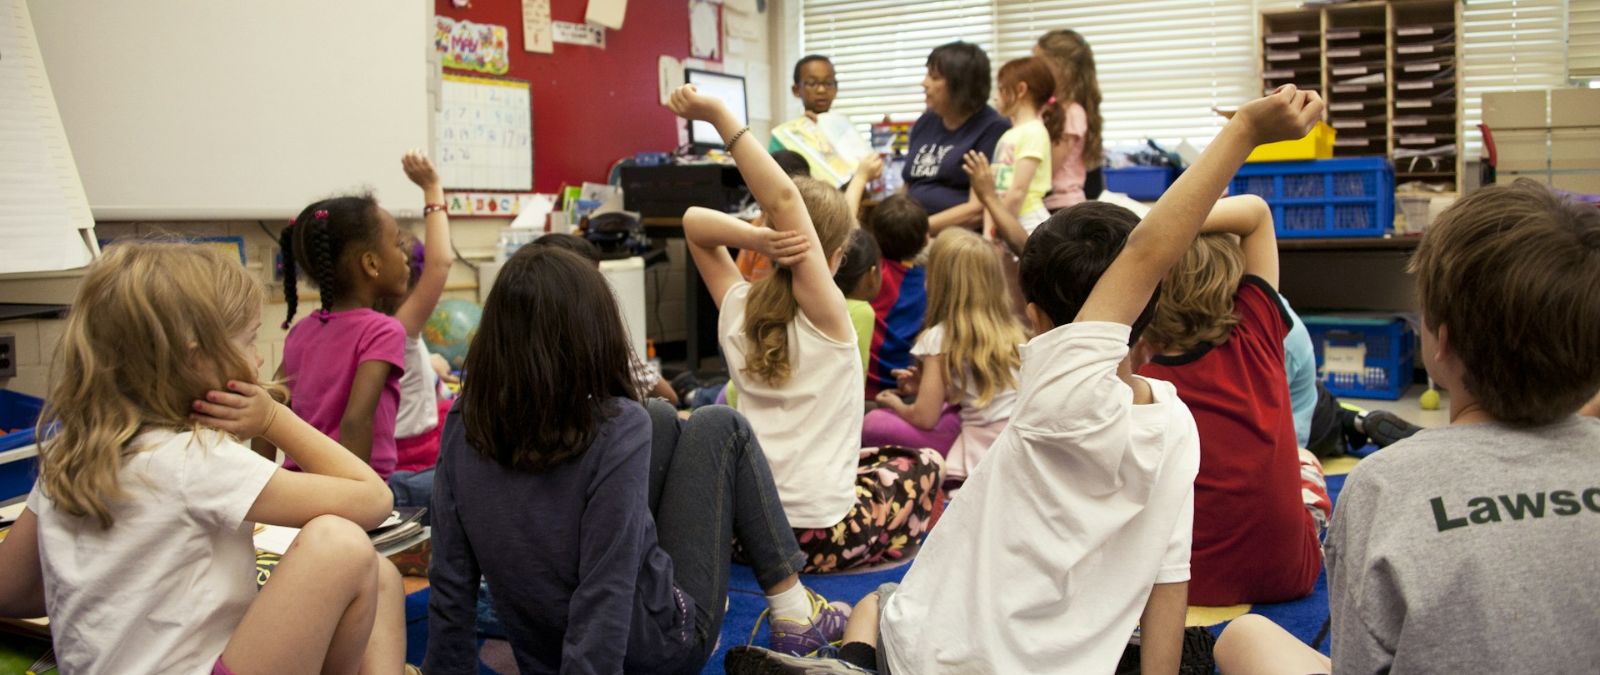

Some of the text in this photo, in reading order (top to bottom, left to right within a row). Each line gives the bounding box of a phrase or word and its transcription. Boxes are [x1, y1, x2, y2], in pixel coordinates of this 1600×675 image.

[451, 198, 461, 210] A
[501, 199, 510, 211] C
[1430, 487, 1600, 532] Lawso
